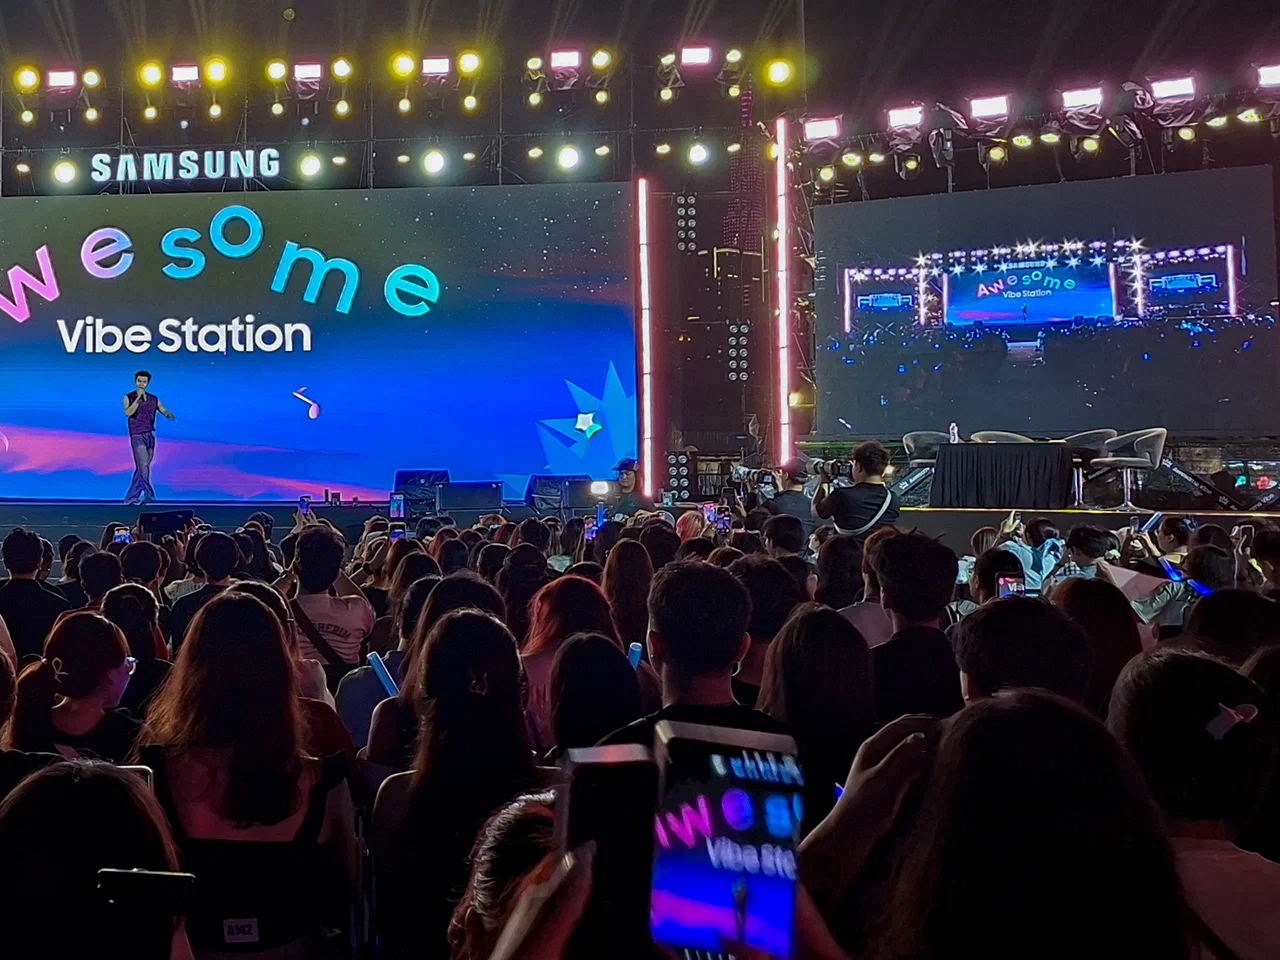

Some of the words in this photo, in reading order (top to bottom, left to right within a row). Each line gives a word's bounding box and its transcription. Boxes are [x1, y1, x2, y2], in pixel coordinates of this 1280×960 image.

[91, 148, 280, 182] SAMSUNG
[977, 270, 1076, 298] Awesome
[57, 316, 152, 353] Vibe
[157, 314, 312, 353] Station
